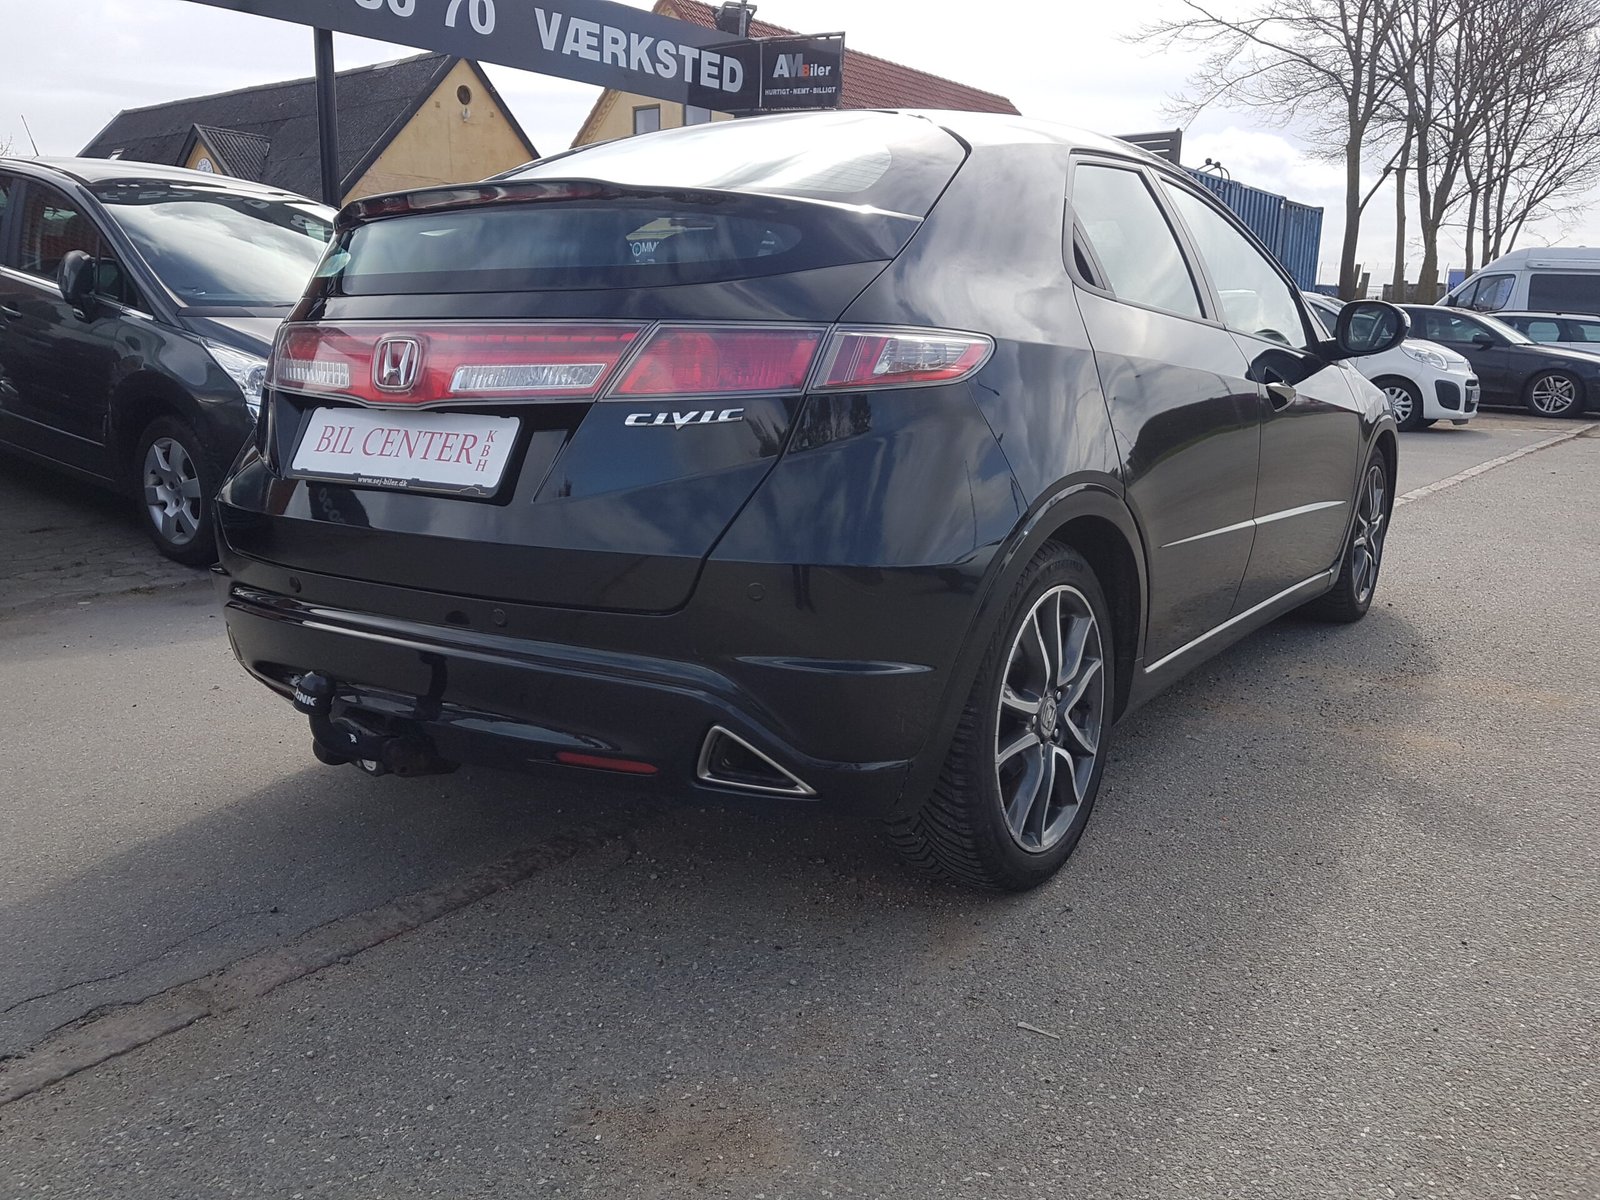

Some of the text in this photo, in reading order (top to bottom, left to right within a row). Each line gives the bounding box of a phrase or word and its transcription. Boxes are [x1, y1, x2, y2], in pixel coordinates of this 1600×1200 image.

[534, 7, 744, 93] VÆRKSTED
[624, 408, 745, 430] CIVIC
[314, 425, 478, 465] BIL CENTER
